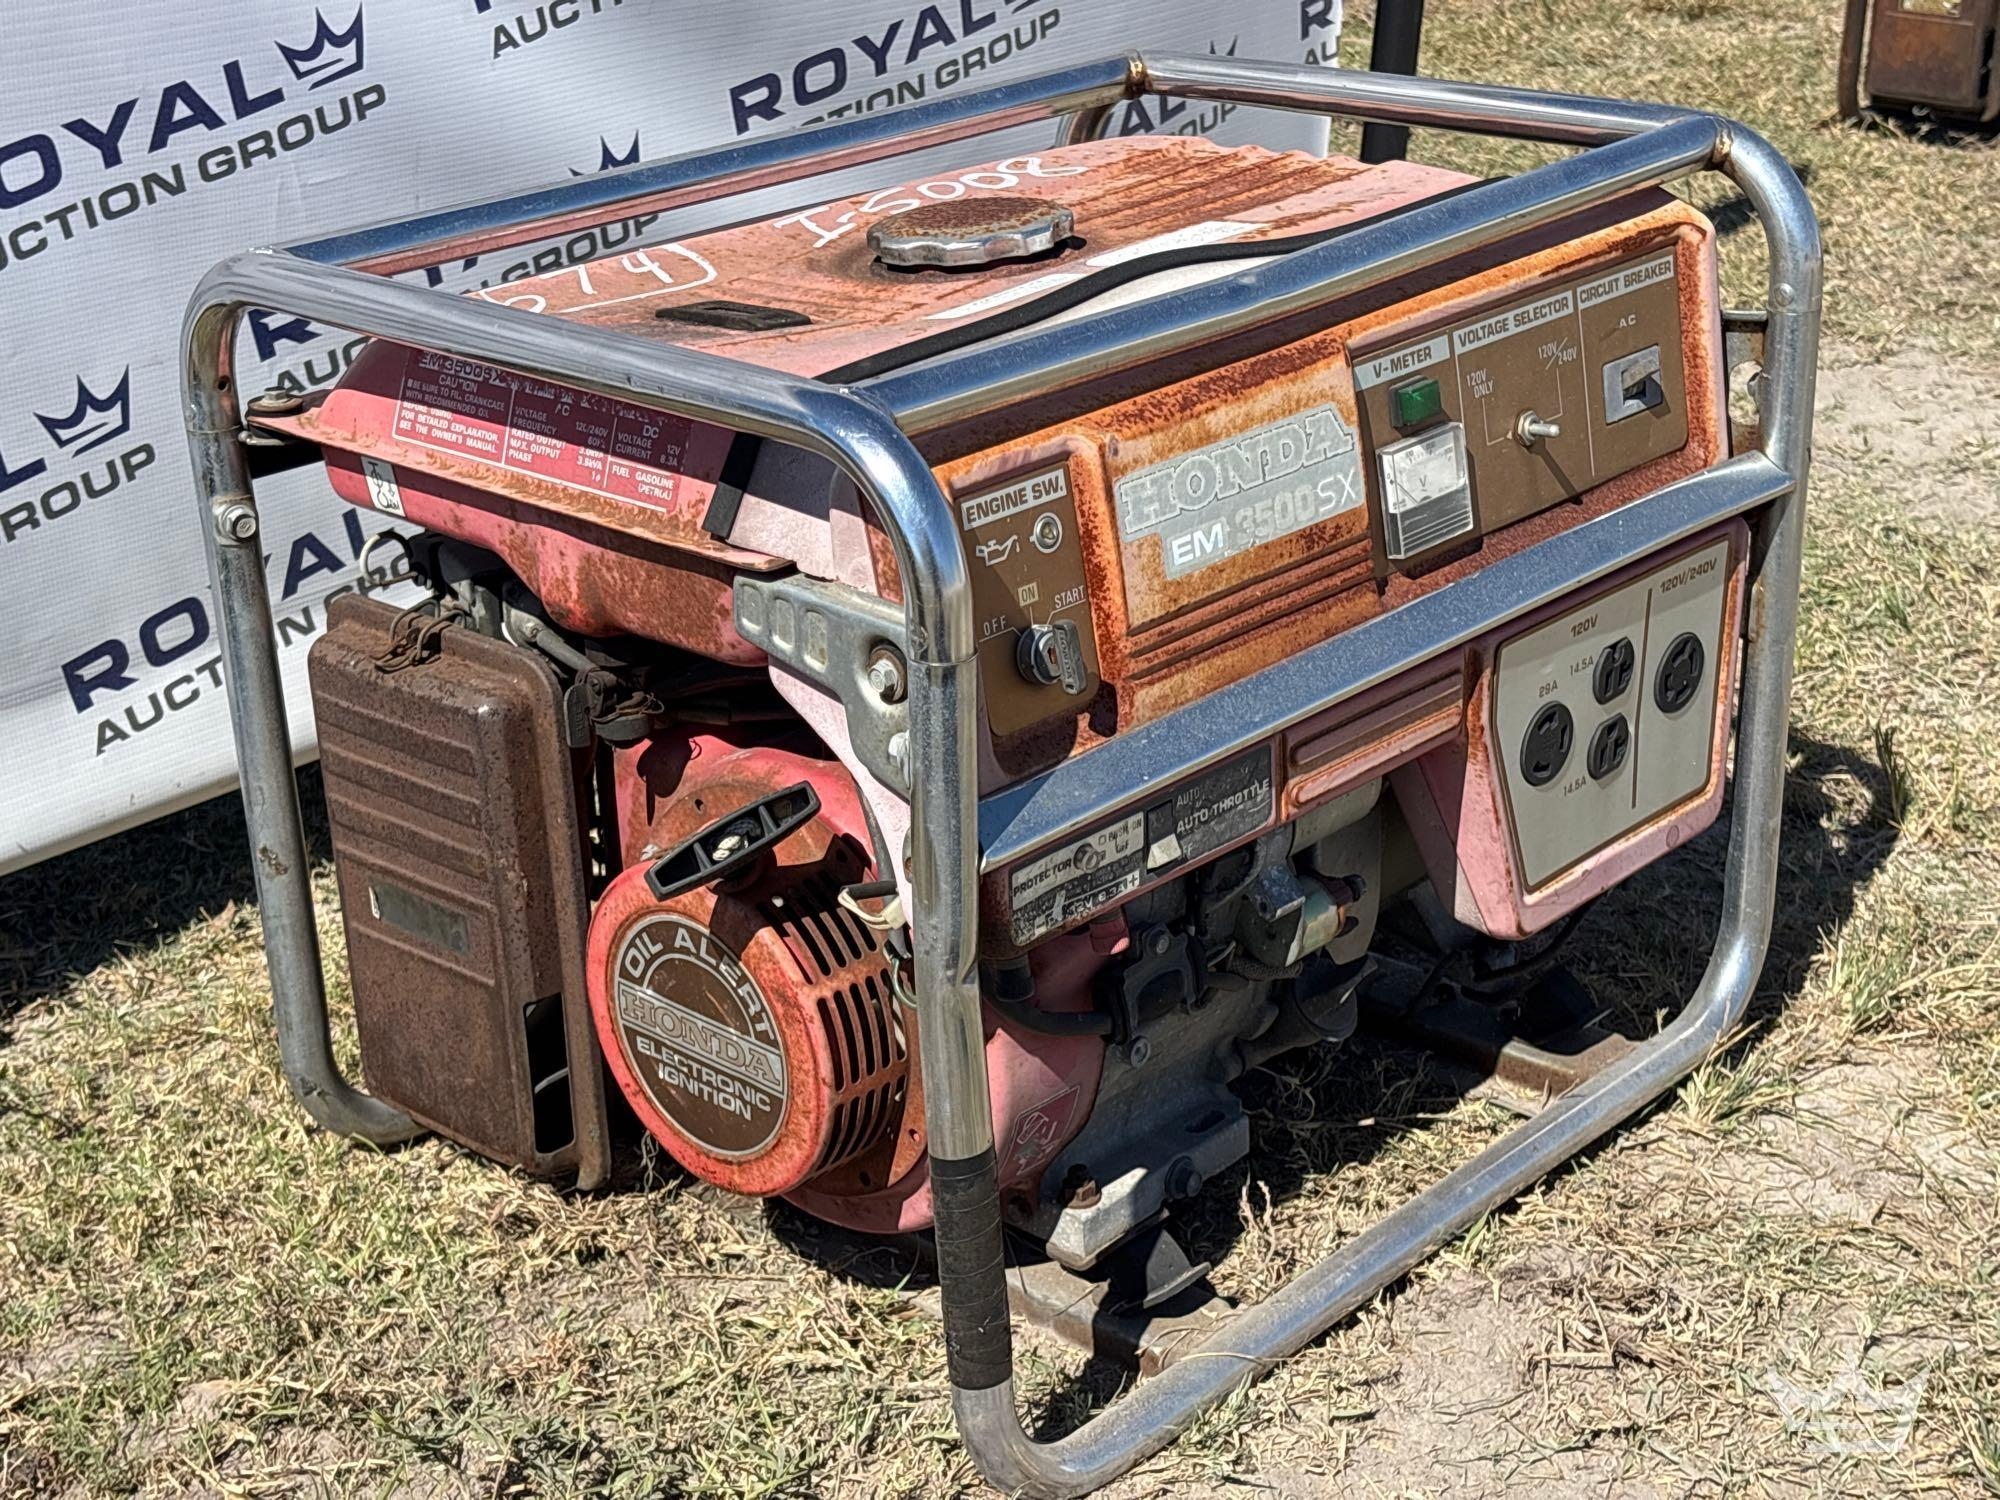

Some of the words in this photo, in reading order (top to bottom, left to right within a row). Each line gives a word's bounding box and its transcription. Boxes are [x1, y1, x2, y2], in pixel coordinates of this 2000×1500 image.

[934, 8, 1061, 90] GROUP
[730, 0, 996, 136] ROYAL
[0, 163, 188, 273] CTION
[198, 83, 388, 183] GROUP
[1579, 278, 1620, 304] CIRCUIT
[1623, 260, 1672, 288] BREAKER
[1458, 313, 1510, 348] VOLTAGE
[1513, 296, 1570, 328] SELECTOR
[1618, 313, 1638, 328] AC
[1372, 344, 1433, 380] V-METER
[1466, 367, 1488, 388] 120V
[1473, 380, 1495, 399] ONLY
[405, 388, 423, 400] WITH
[424, 393, 477, 415] RECOMMENDED
[440, 386, 450, 397] TO
[401, 409, 415, 420] FOR
[417, 413, 449, 429] DETAILED
[513, 416, 558, 435] FREQUENCY
[515, 406, 548, 423] VOLTAGE
[399, 420, 412, 431] SEE
[415, 423, 429, 435] THE
[431, 428, 463, 444] OWNER'S
[511, 427, 536, 440] RATED
[536, 433, 566, 449] OUTPUT
[618, 432, 653, 449] VOLTAGE
[666, 444, 681, 456] 12V
[642, 424, 660, 439] DC
[508, 448, 533, 463] PHASE
[530, 442, 561, 459] OUTPUT
[615, 443, 652, 460] CURRENT
[611, 464, 631, 479] FUEL
[635, 471, 675, 490] GASOLINE
[1119, 407, 1357, 535] HONDA
[965, 489, 1028, 525] ENGINE
[1031, 475, 1064, 502] SW.
[1170, 522, 1225, 566] EM
[1659, 557, 1718, 594] 120V/240V
[1021, 585, 1038, 604] ON
[1053, 585, 1086, 610] START
[61, 507, 394, 714] ROAL
[982, 615, 1007, 638] OFF
[1570, 613, 1599, 638] 120V
[1569, 657, 1594, 676] 14.5A
[1176, 785, 1201, 809] AUTO
[1563, 776, 1587, 796] 14.5A
[1013, 858, 1072, 897] PROTECTOR
[624, 931, 664, 979] OIL
[673, 926, 777, 1041] ALERT
[621, 988, 781, 1087] HONDA
[636, 1035, 772, 1112] ELECTRONIC
[658, 1062, 752, 1121] IGNITION
